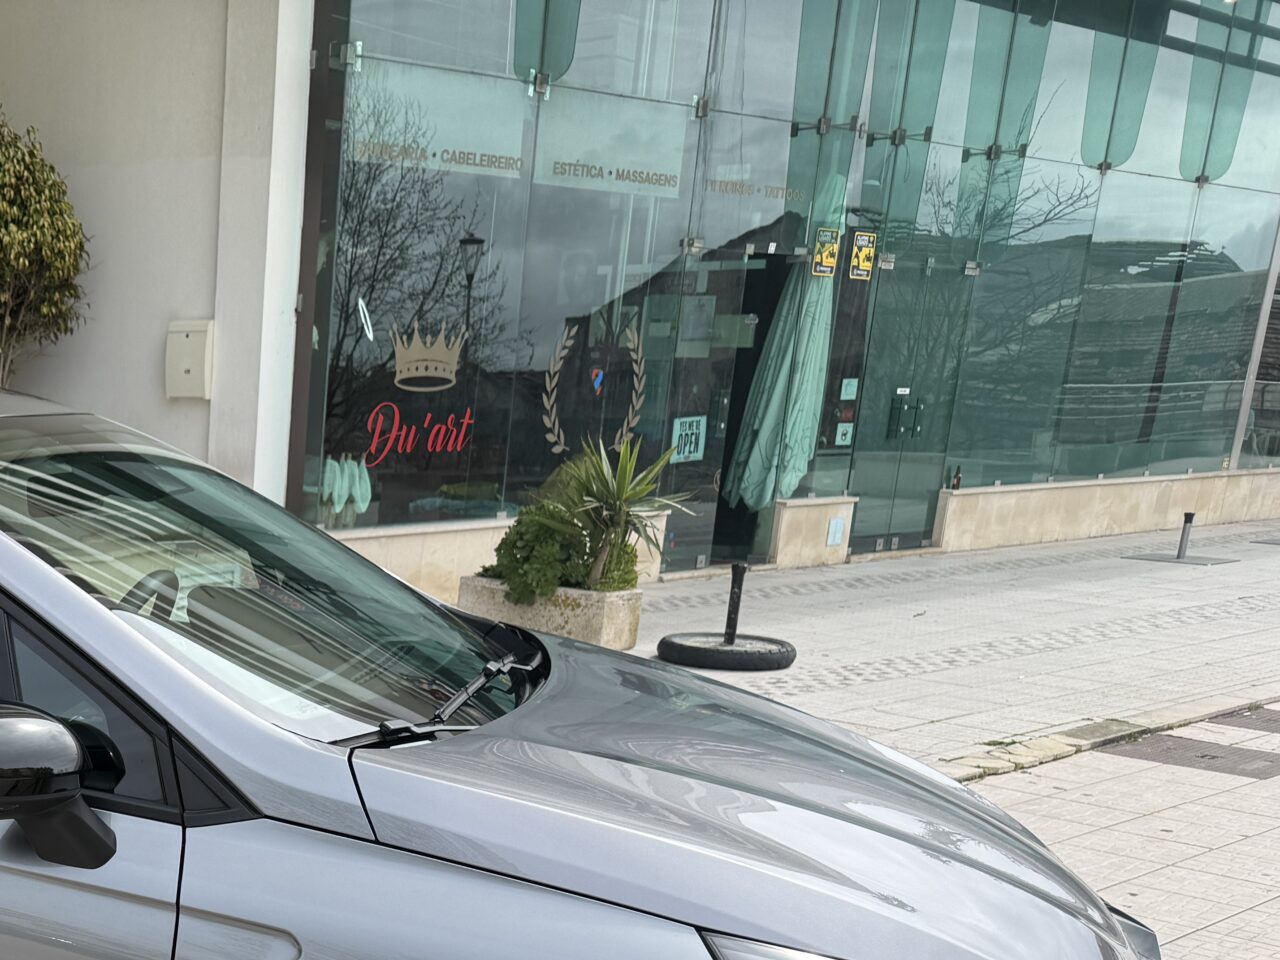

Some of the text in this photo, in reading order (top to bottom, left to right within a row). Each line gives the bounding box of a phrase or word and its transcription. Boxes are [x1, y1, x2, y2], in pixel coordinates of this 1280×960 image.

[552, 160, 679, 189] ESTÉTICA MASSAGENS
[365, 401, 475, 468] Du'art
[676, 431, 701, 456] OPEN
